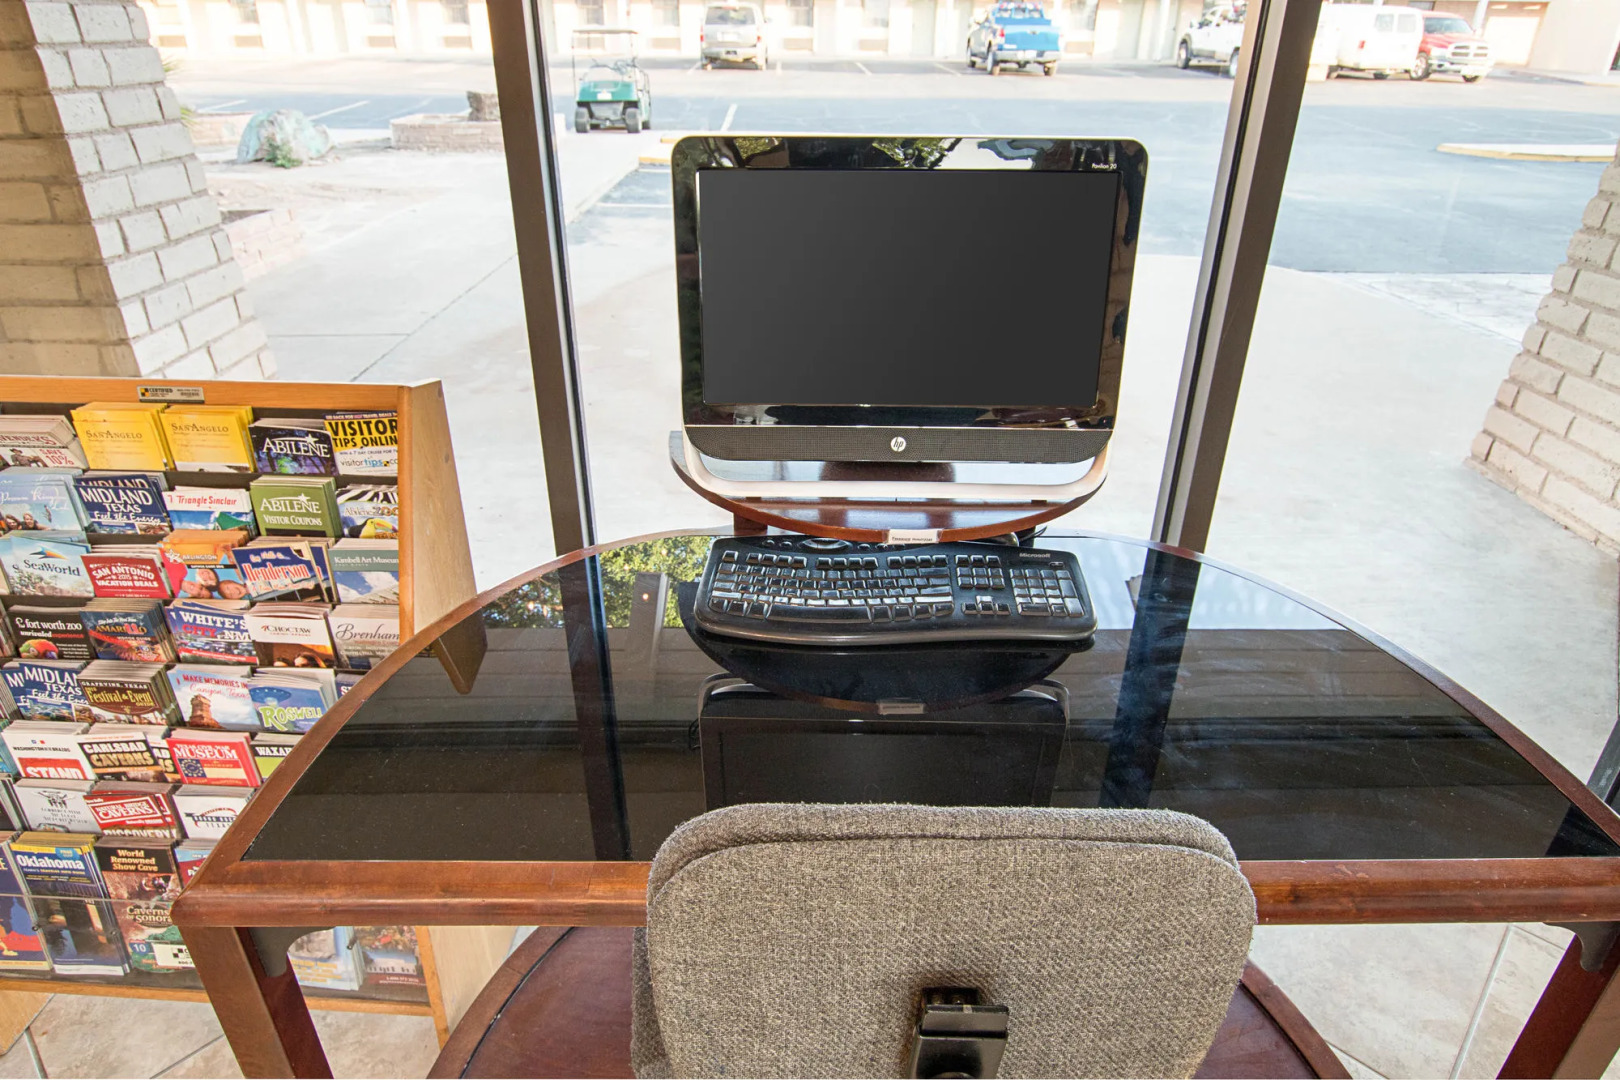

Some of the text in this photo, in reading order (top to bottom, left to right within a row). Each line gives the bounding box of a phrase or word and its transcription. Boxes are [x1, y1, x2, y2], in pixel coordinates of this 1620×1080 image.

[262, 437, 330, 458] ABILENE
[332, 435, 398, 447] TIPS ONLIN
[892, 437, 905, 451] hp
[79, 487, 153, 505] MIDLAND
[176, 495, 237, 507] Triangle Sinclair
[102, 503, 142, 513] TEXAS
[260, 498, 322, 513] ABILENE
[94, 511, 112, 520] Feel
[263, 514, 290, 524] VISITOR
[23, 559, 81, 577] SeaWorld
[92, 566, 155, 581] SAN ANTONIO
[241, 562, 311, 582] Henderson
[134, 580, 159, 588] DEALS
[25, 618, 83, 630] fort worth zoo
[179, 611, 248, 630] WHITE'S
[96, 623, 148, 635] AMARILLO
[221, 630, 252, 642] NM
[24, 666, 78, 687] MIDLA
[182, 674, 202, 683] MAKE
[203, 677, 240, 688] MEMORIES
[32, 689, 49, 698] Feel
[44, 682, 82, 696] TEXAS
[88, 690, 123, 703] Festival
[127, 690, 153, 703] Event
[259, 706, 323, 731] ROSWELL
[82, 741, 147, 754] CARLSBAD
[173, 747, 238, 760] MUSEUM
[90, 751, 154, 767] CAVERNS
[98, 805, 154, 819] CAVERNS
[117, 849, 145, 858] World
[16, 855, 85, 870] Oklahoma
[110, 856, 156, 865] Renowned
[113, 863, 158, 872] Show Cave
[127, 906, 170, 916] Caverns
[133, 944, 147, 953] 10
